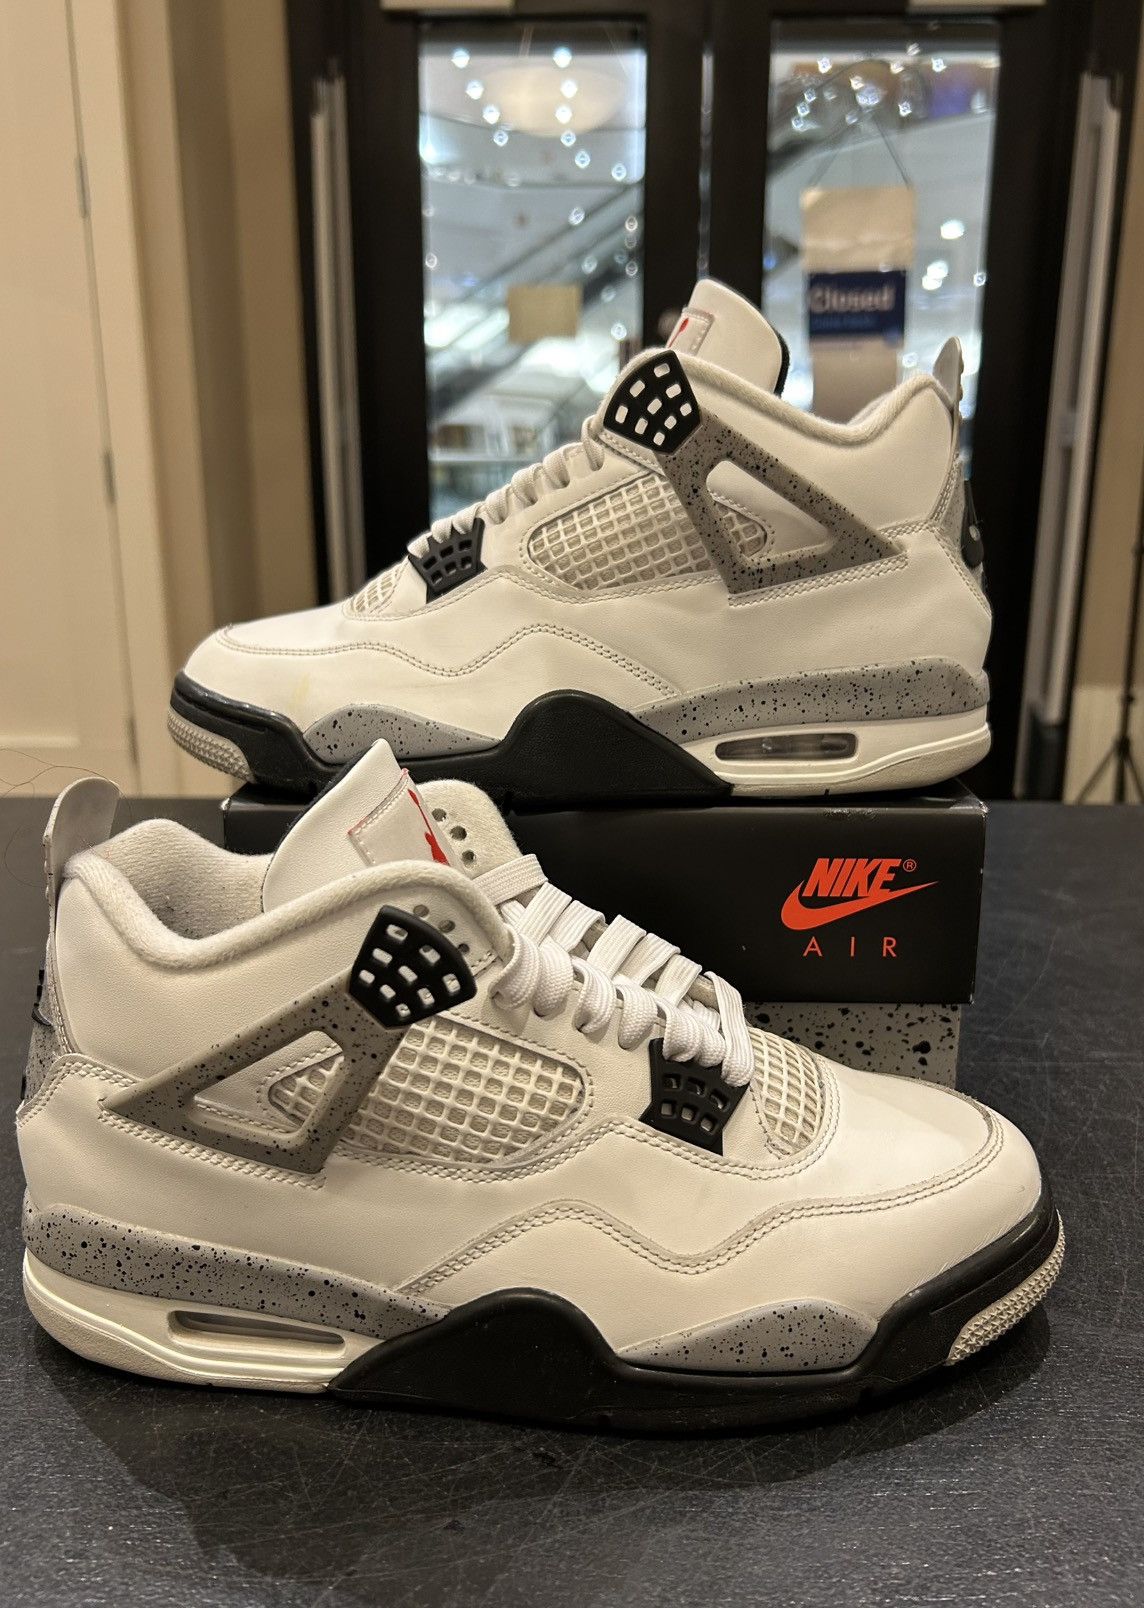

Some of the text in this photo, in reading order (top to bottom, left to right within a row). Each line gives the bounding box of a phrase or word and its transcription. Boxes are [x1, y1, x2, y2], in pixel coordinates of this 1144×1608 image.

[810, 284, 896, 313] Closed
[802, 858, 902, 897] NIKE
[803, 936, 898, 957] AIR
